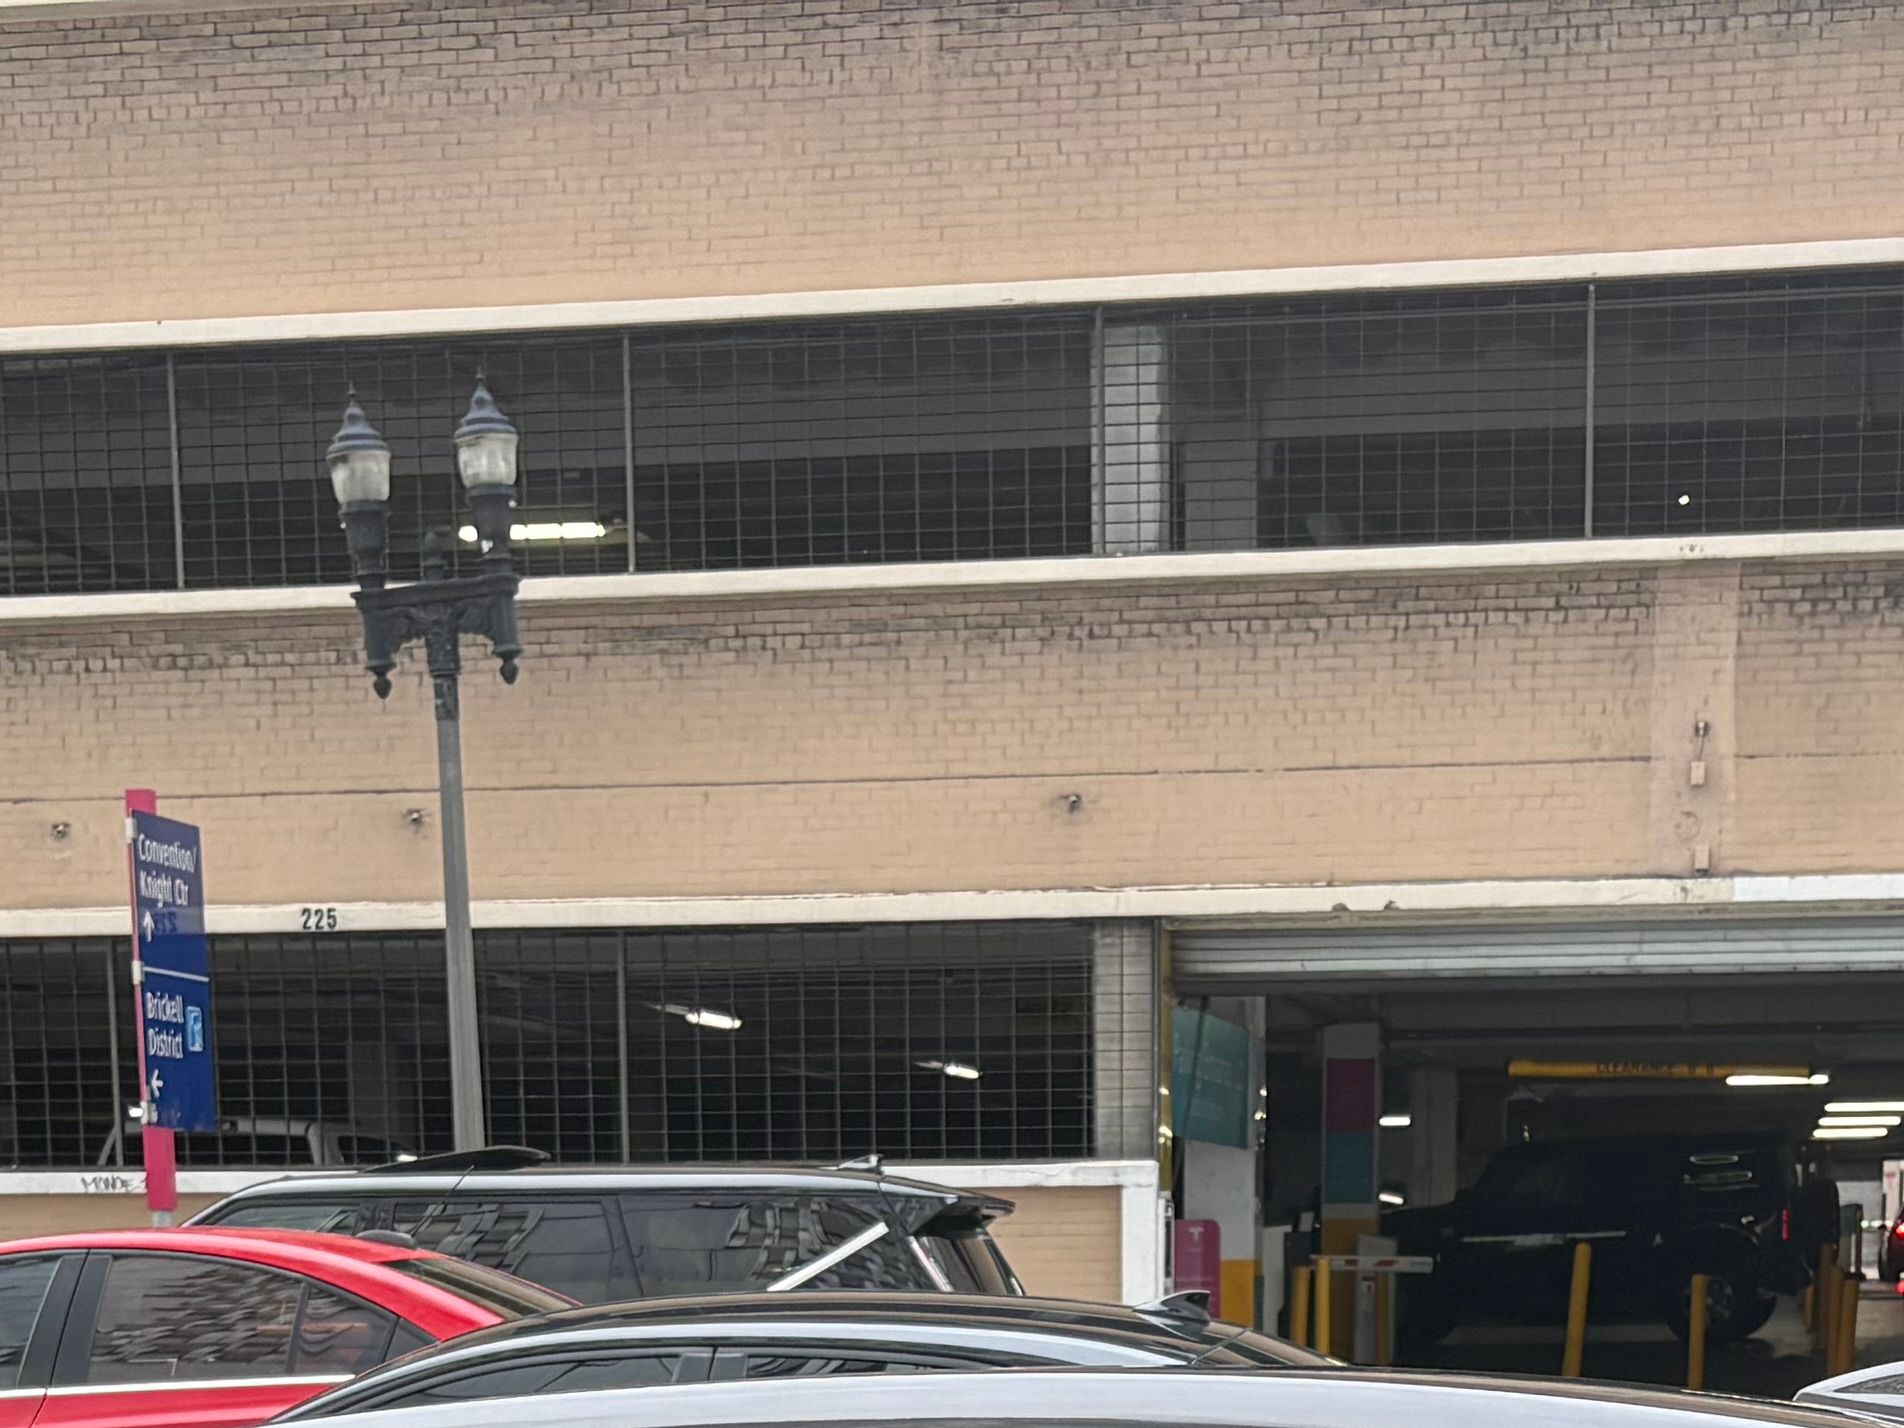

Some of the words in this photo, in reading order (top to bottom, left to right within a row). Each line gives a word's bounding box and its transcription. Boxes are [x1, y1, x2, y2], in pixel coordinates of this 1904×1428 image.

[138, 833, 197, 873] Convention/
[140, 870, 173, 908] Knight
[174, 879, 189, 906] Ctr
[301, 907, 337, 930] 225
[145, 991, 184, 1024] Brickell
[147, 1027, 183, 1059] District
